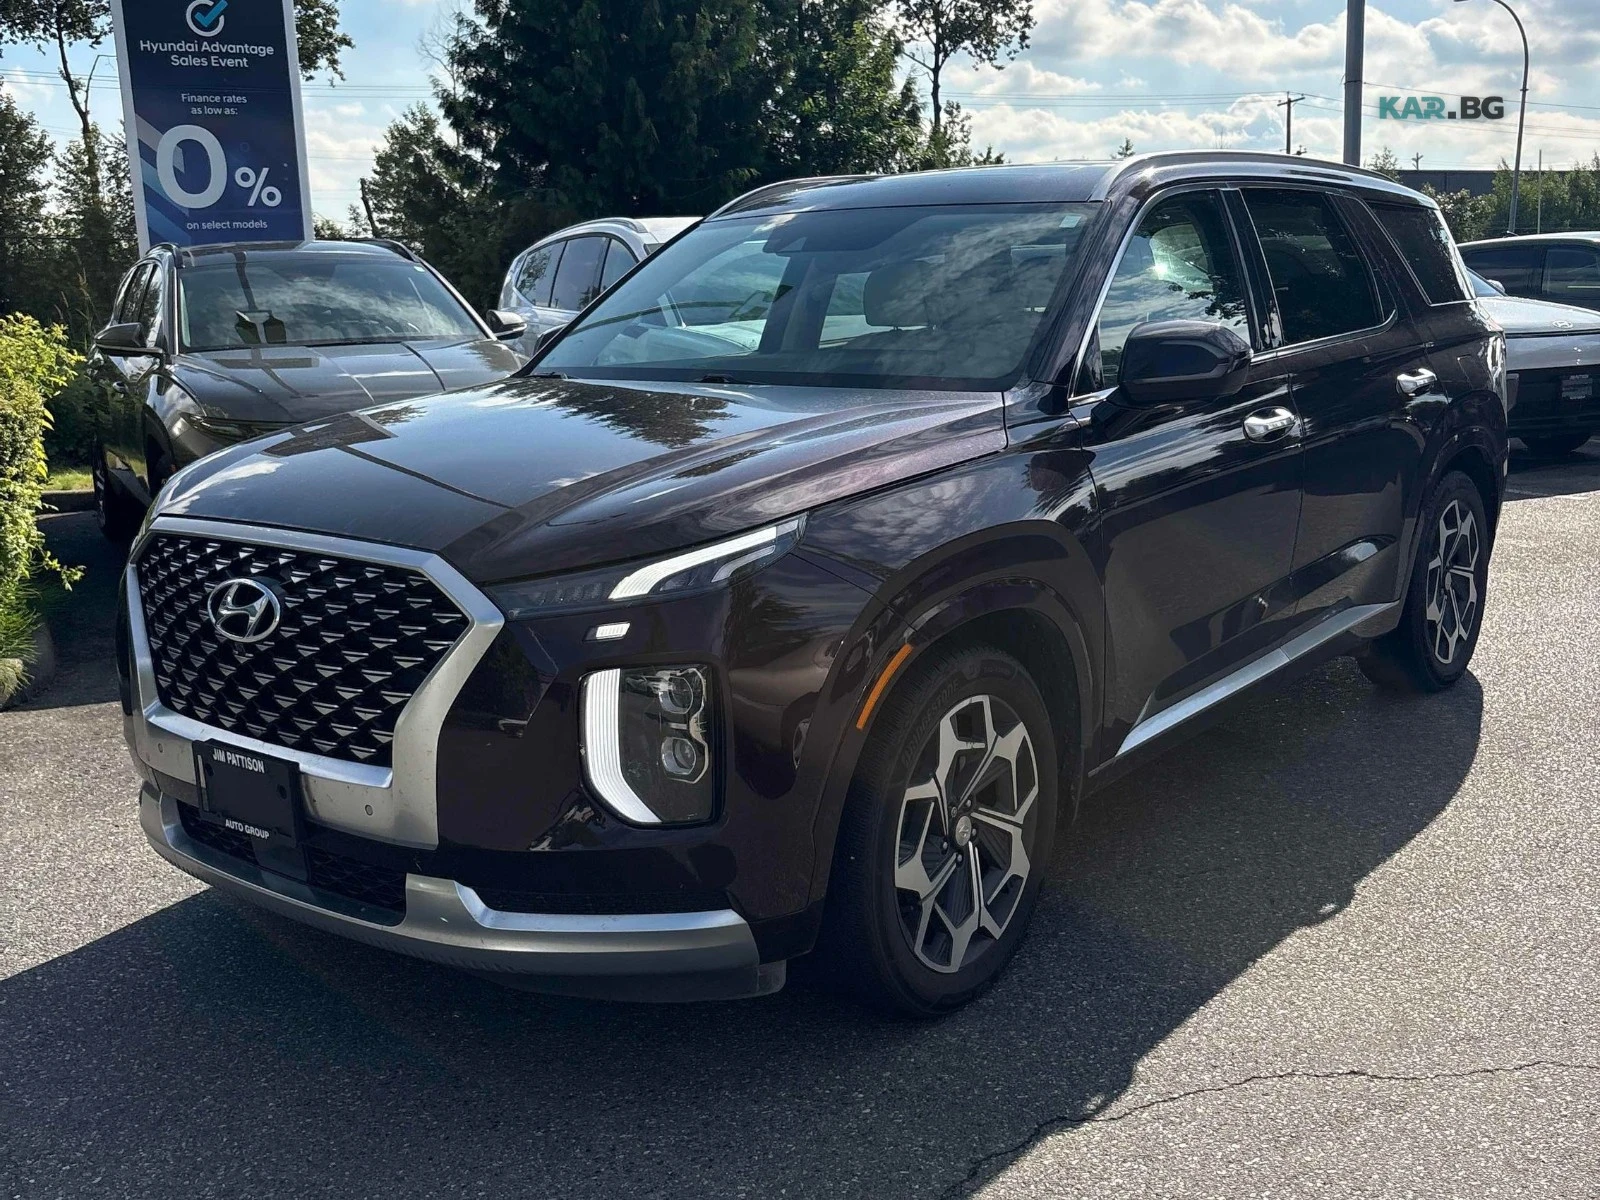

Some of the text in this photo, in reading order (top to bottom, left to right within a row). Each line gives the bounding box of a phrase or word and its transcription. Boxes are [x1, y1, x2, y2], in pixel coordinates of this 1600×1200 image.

[140, 40, 275, 57] Hyundai Advantage
[170, 54, 249, 68] Sales Event
[181, 93, 248, 104] Finance rates
[190, 105, 238, 115] as low as:
[186, 219, 268, 230] on select models
[212, 747, 265, 774] JIM PATTISON
[225, 819, 270, 839] AUTO GROUP
